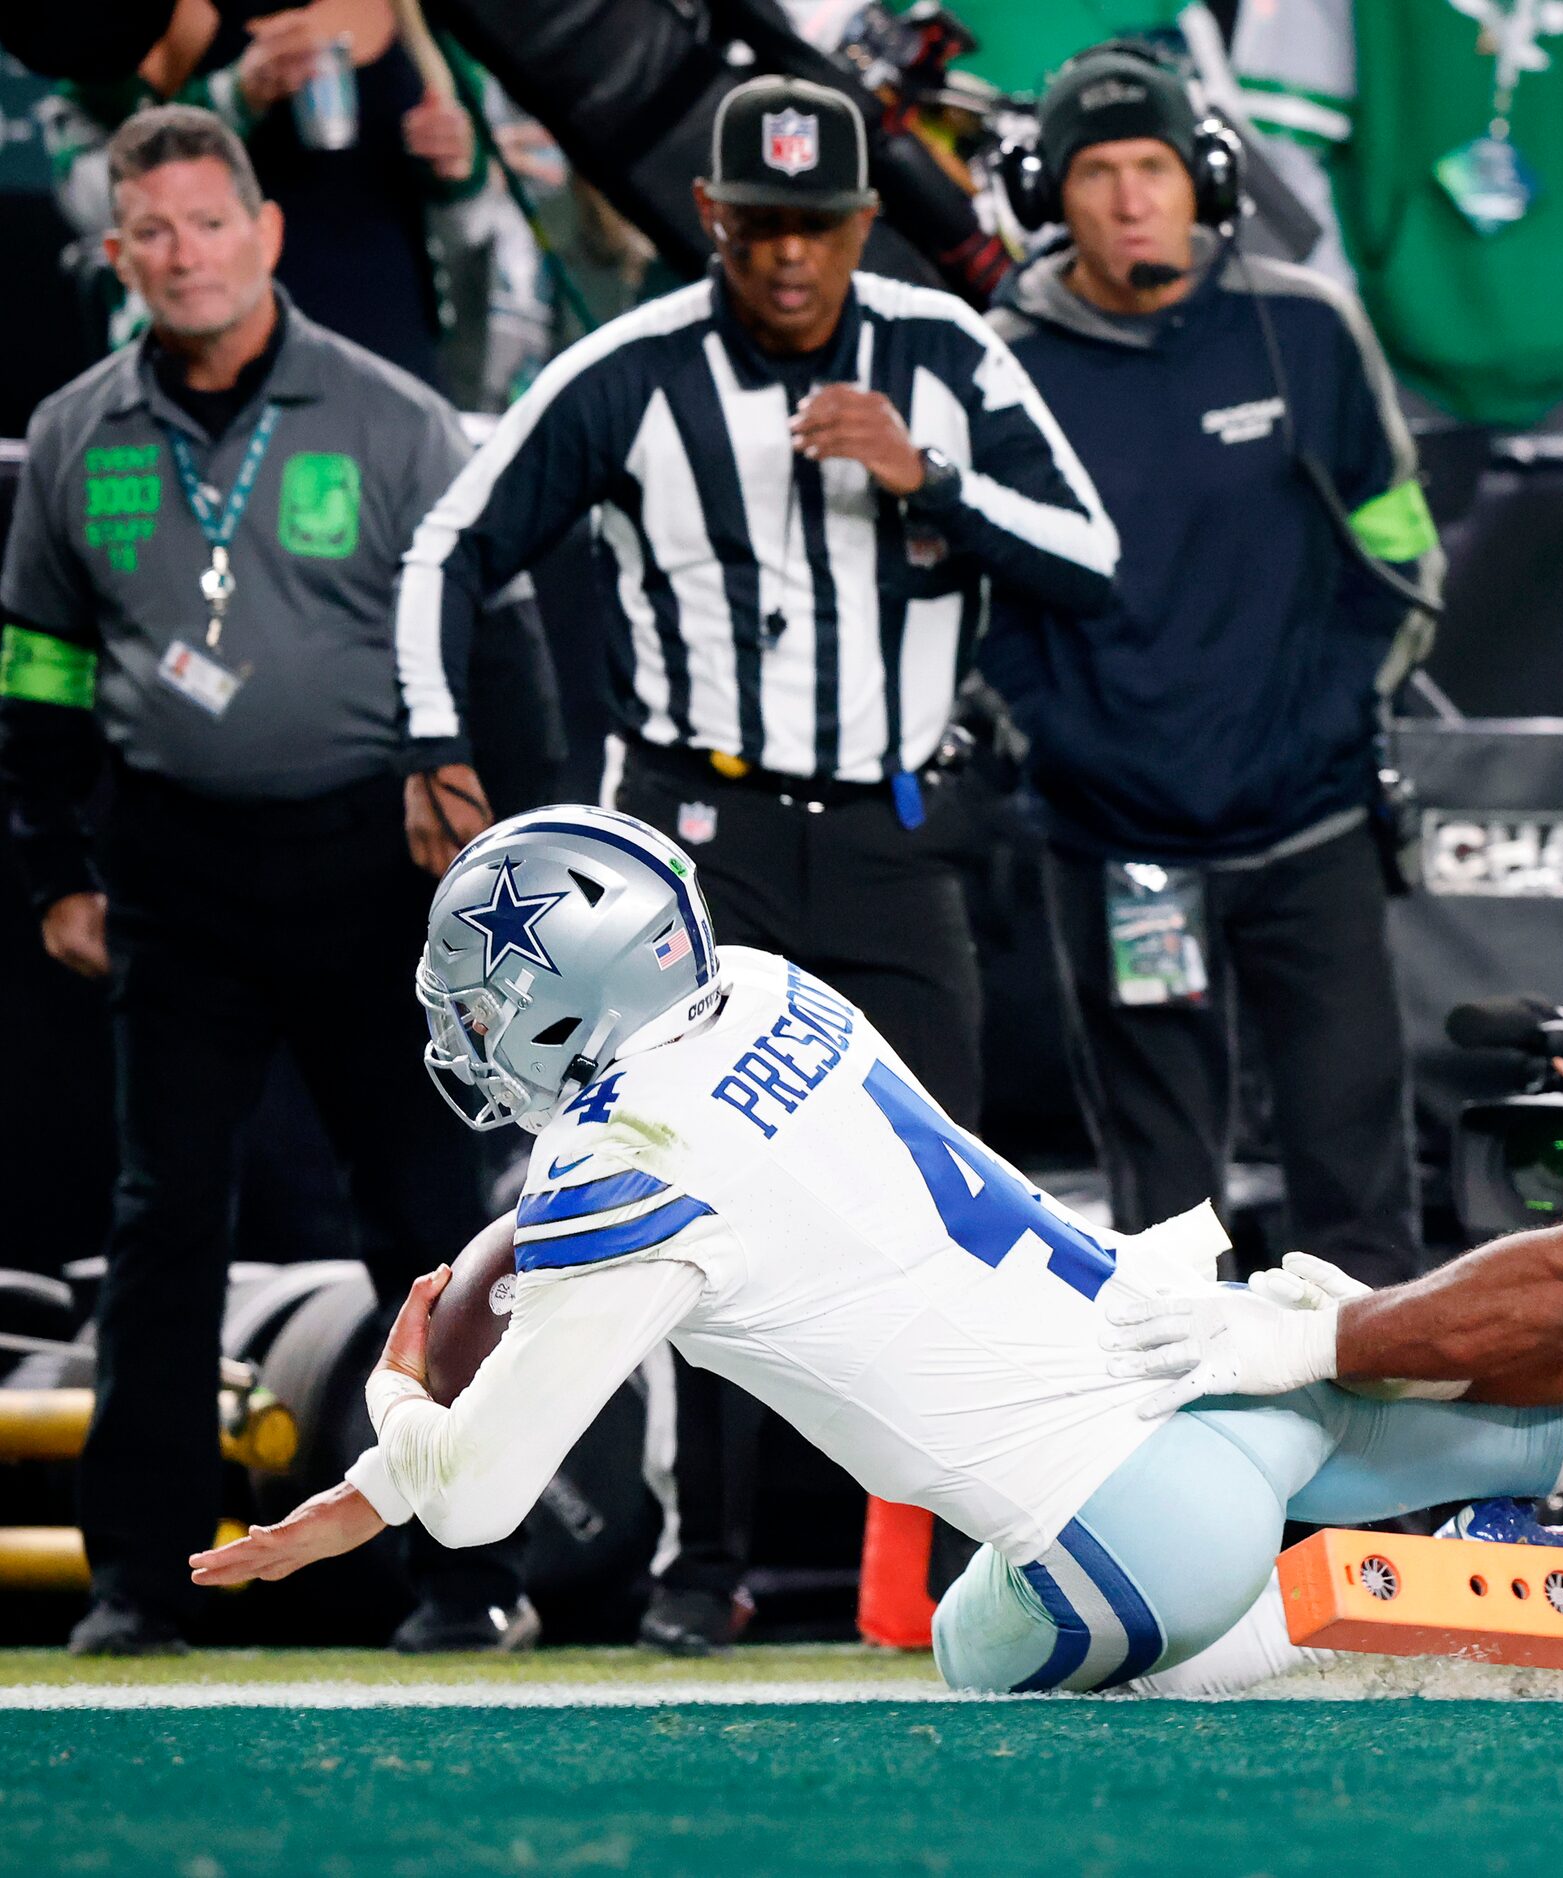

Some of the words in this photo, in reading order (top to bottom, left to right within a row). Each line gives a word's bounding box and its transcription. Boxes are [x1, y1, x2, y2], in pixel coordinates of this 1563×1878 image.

[85, 443, 160, 473] EVENT
[85, 517, 156, 549] STAFF
[562, 1070, 628, 1127] 4
[862, 1057, 1118, 1303] 4
